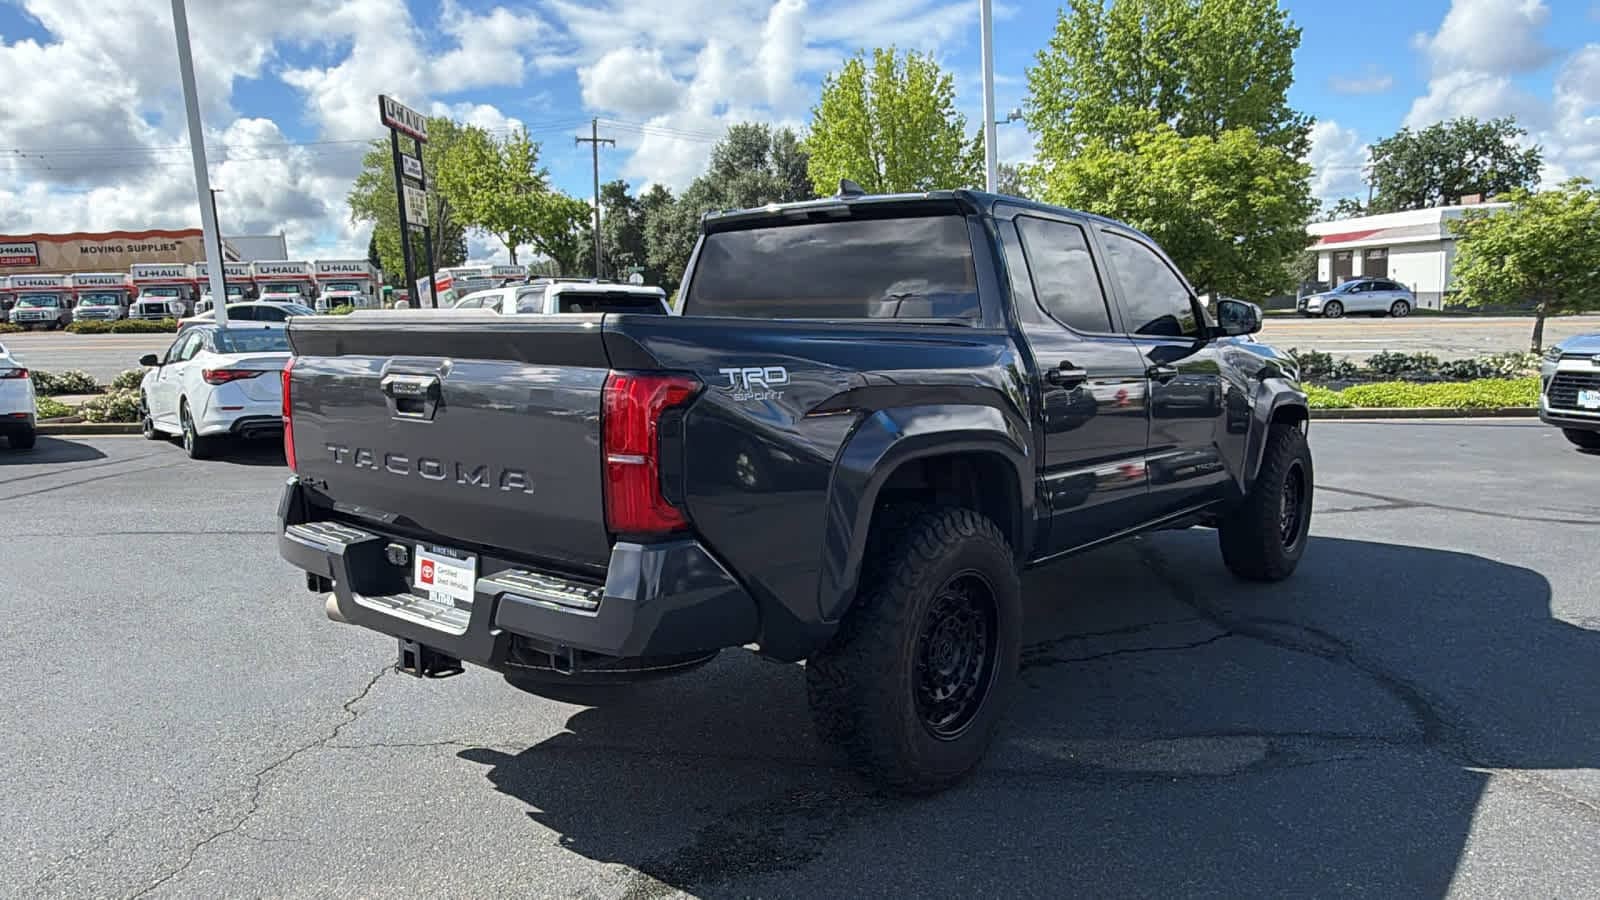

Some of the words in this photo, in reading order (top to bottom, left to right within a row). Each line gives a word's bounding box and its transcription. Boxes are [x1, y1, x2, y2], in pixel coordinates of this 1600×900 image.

[386, 100, 427, 134] U-HAUL
[80, 245, 123, 254] MOVING
[127, 243, 177, 253] SUPPLIES
[260, 266, 303, 274] U-HAUL
[321, 264, 363, 272] U-HAUL
[718, 366, 788, 389] TRD
[733, 391, 785, 401] SPORT
[325, 443, 535, 494] TACOMA
